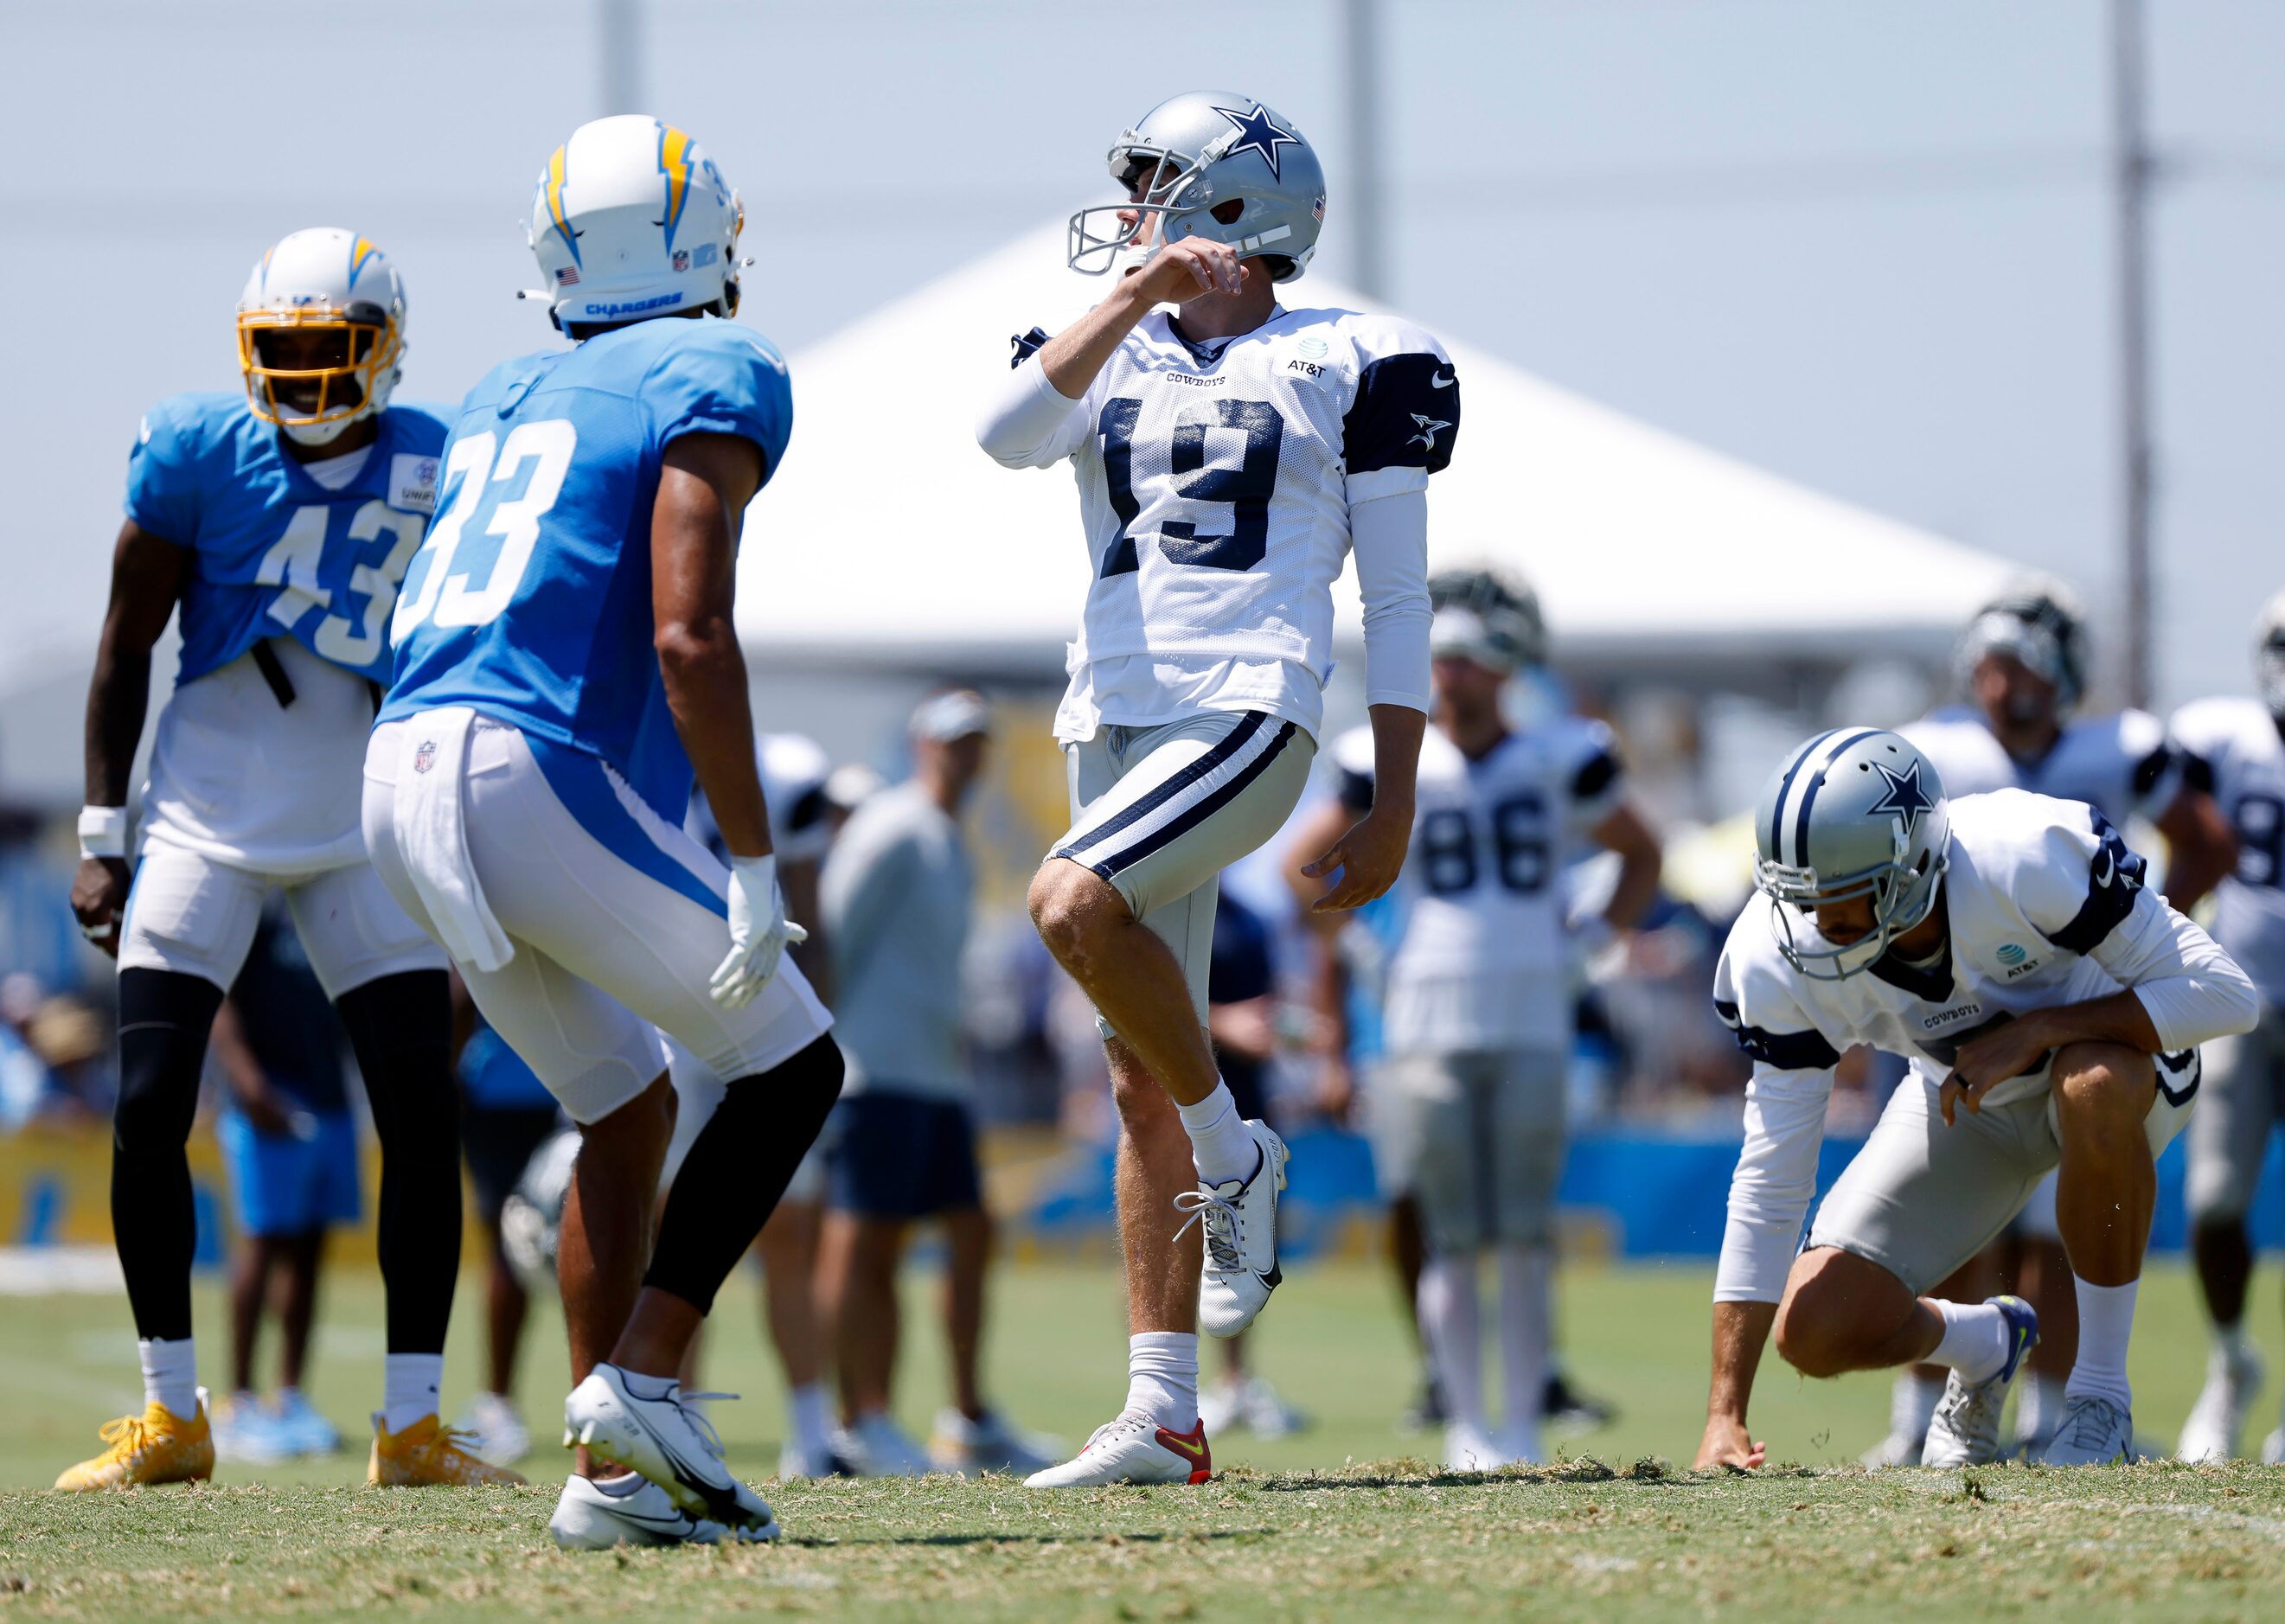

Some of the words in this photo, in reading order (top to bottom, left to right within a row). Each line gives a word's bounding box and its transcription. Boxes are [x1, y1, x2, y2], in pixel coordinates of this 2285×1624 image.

[586, 291, 683, 318] CHARGERS
[1167, 373, 1226, 387] COWBOYS
[1287, 360, 1327, 379] AT&T
[1098, 398, 1284, 579] 19
[389, 419, 578, 649] 33
[255, 500, 425, 667] 43
[1420, 792, 1551, 894] 86
[2007, 958, 2039, 979] AT&T
[1923, 1003, 1981, 1029] COWBOYS
